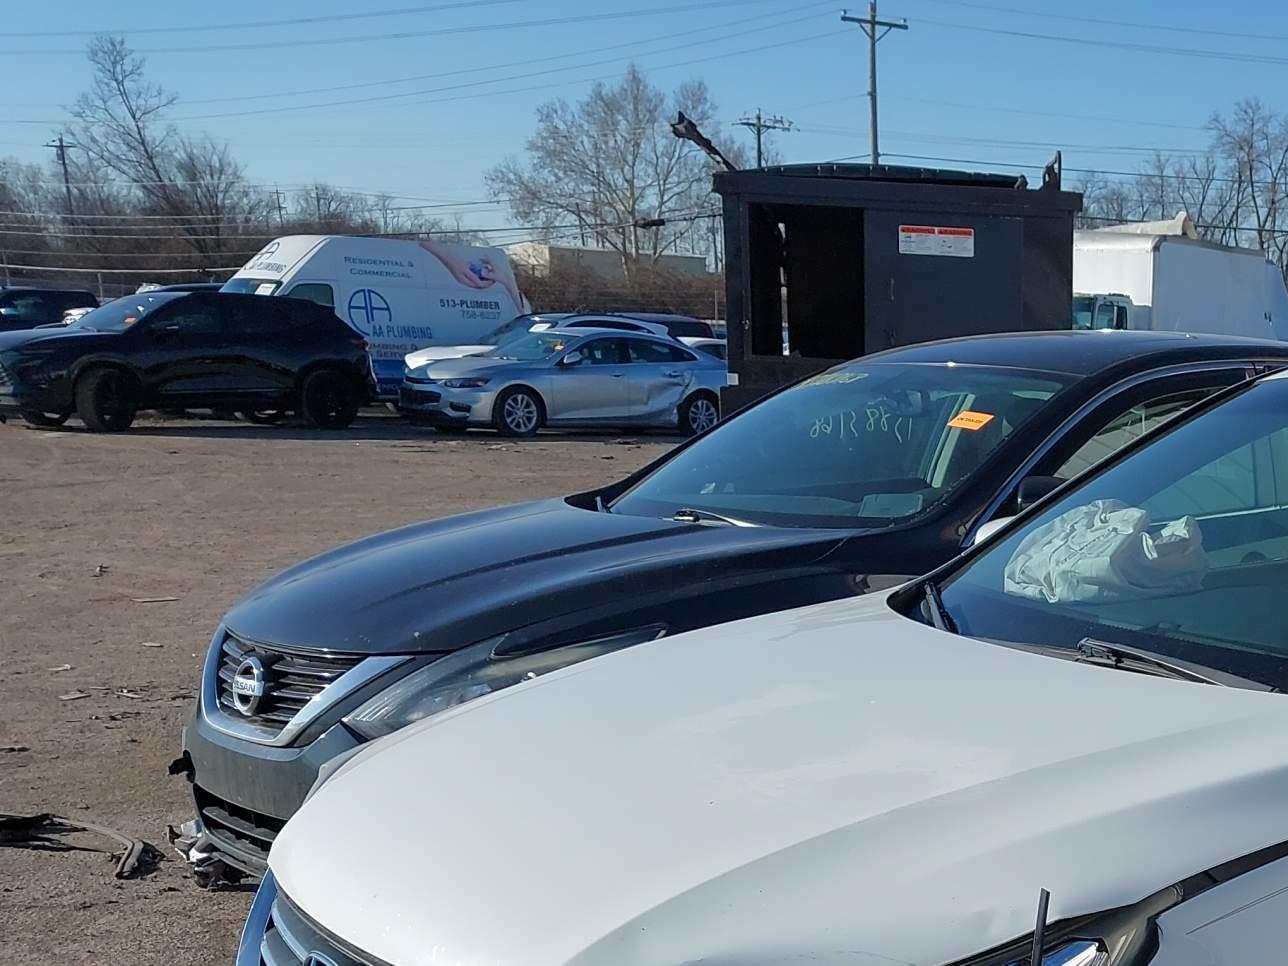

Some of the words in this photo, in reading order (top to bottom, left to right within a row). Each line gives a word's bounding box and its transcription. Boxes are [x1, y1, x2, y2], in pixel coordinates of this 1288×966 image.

[440, 299, 499, 310] 513-PLUMBER
[372, 325, 384, 338] AA
[386, 325, 432, 339] PLUMBING
